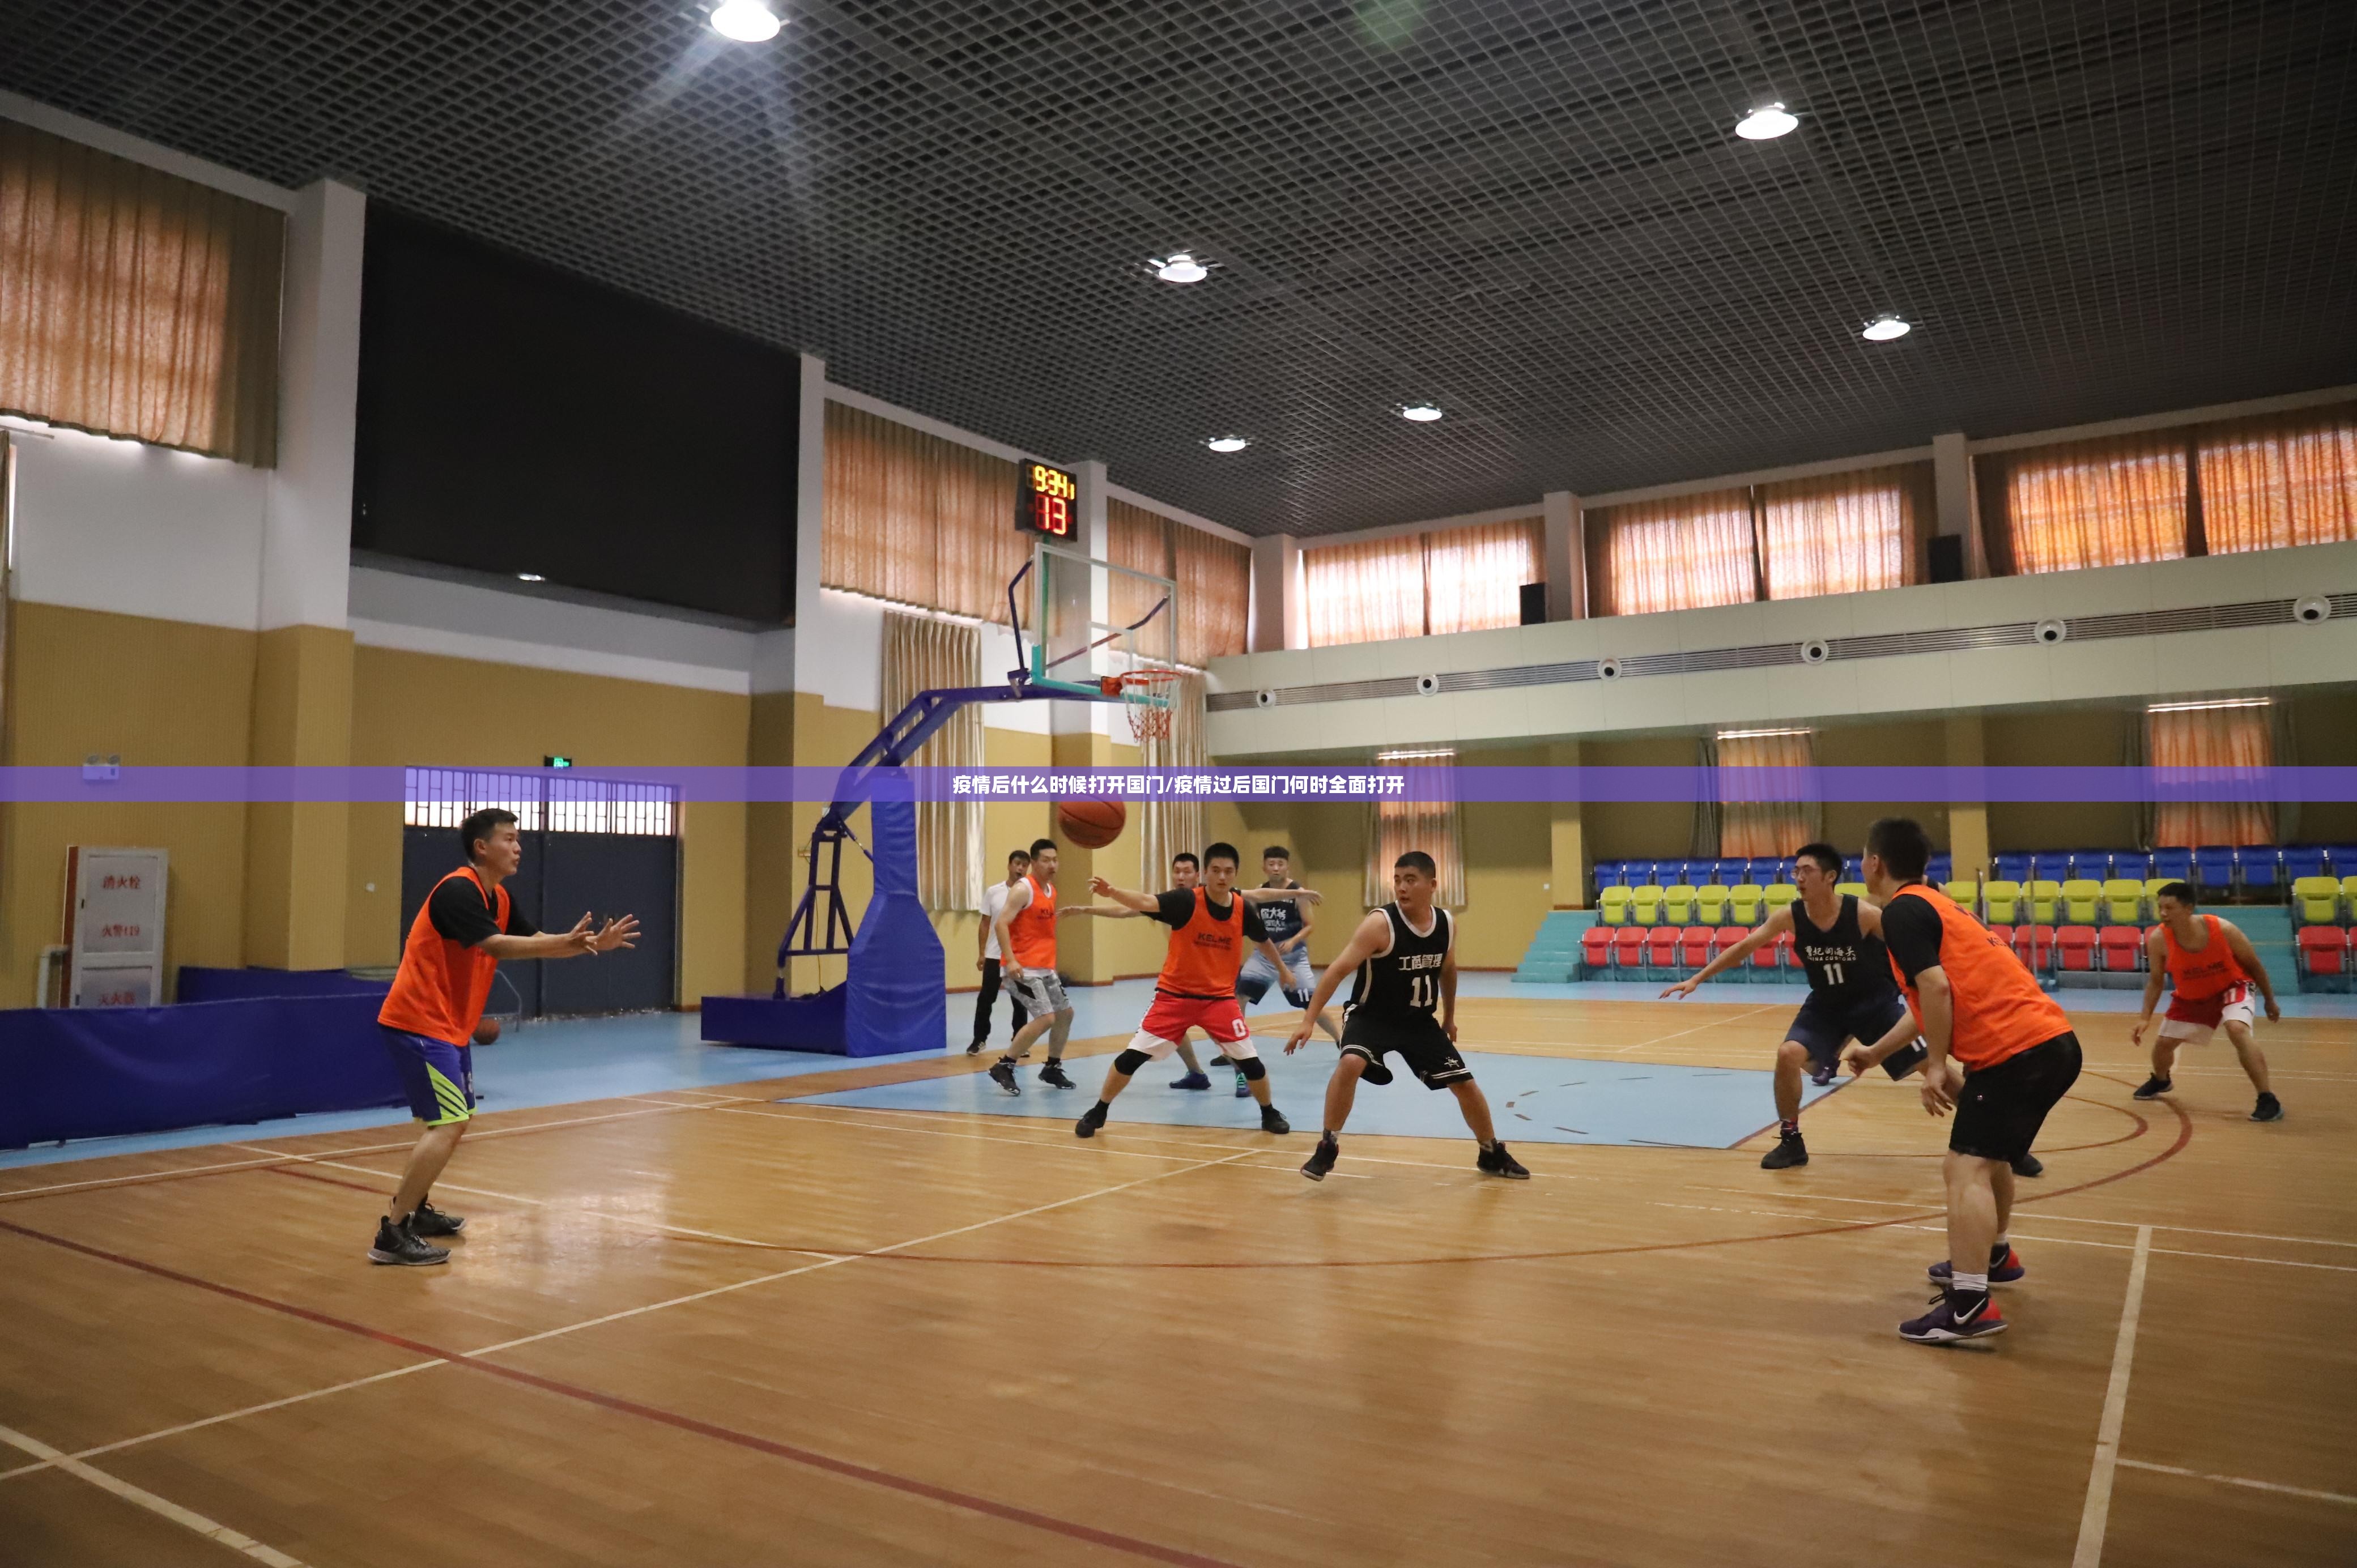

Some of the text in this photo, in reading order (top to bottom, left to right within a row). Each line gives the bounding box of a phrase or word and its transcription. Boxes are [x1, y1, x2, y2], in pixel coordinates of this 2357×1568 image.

[1044, 496, 1066, 535] 13
[103, 875, 141, 889] 消火栓
[102, 924, 140, 938] 火警119
[1823, 963, 1844, 985] 11
[1297, 988, 1309, 1002] 11
[1410, 974, 1433, 1008] 11
[1232, 1018, 1246, 1038] 0
